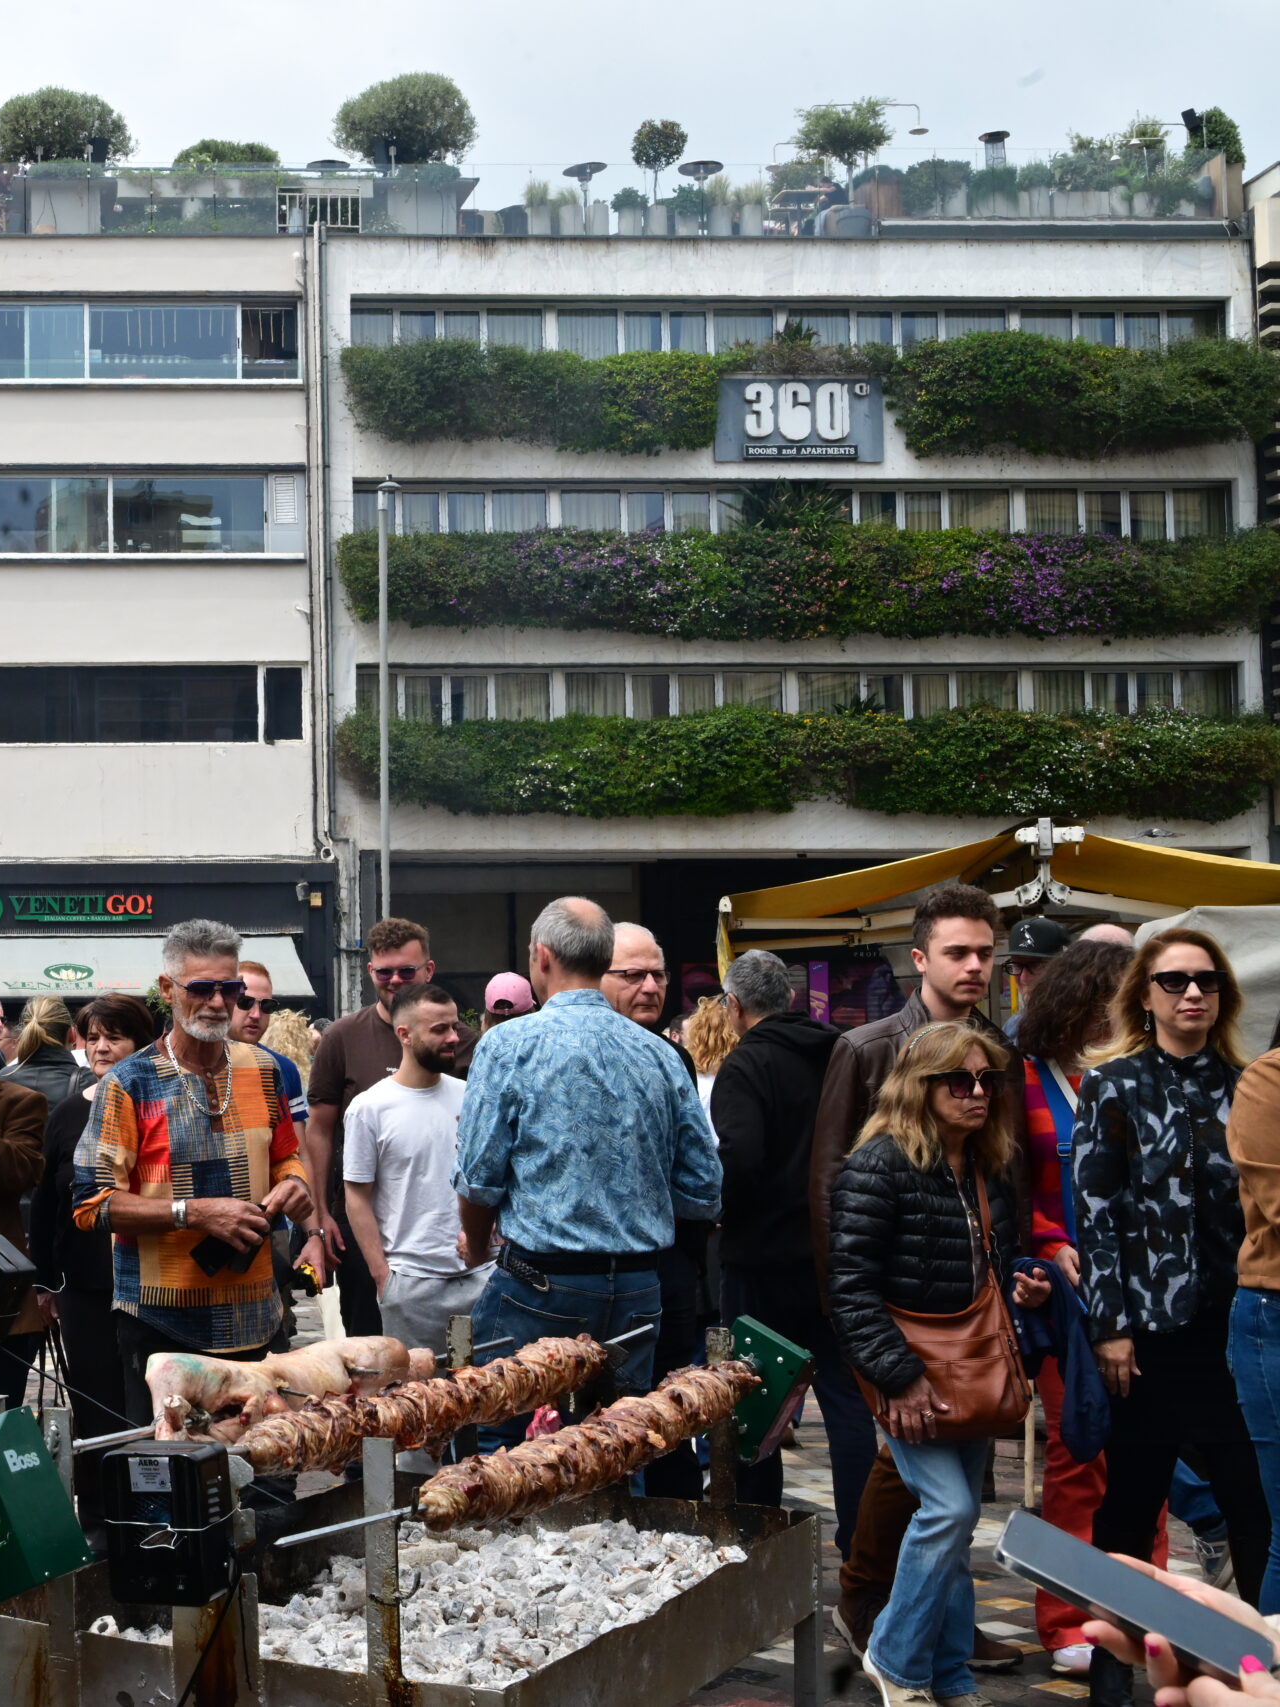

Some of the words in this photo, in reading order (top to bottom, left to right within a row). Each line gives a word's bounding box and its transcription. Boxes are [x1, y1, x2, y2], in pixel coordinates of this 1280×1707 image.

[748, 447, 778, 455] ROOMS
[782, 447, 797, 455] and
[800, 447, 856, 455] APARTMENTS
[138, 1459, 160, 1467] AERO
